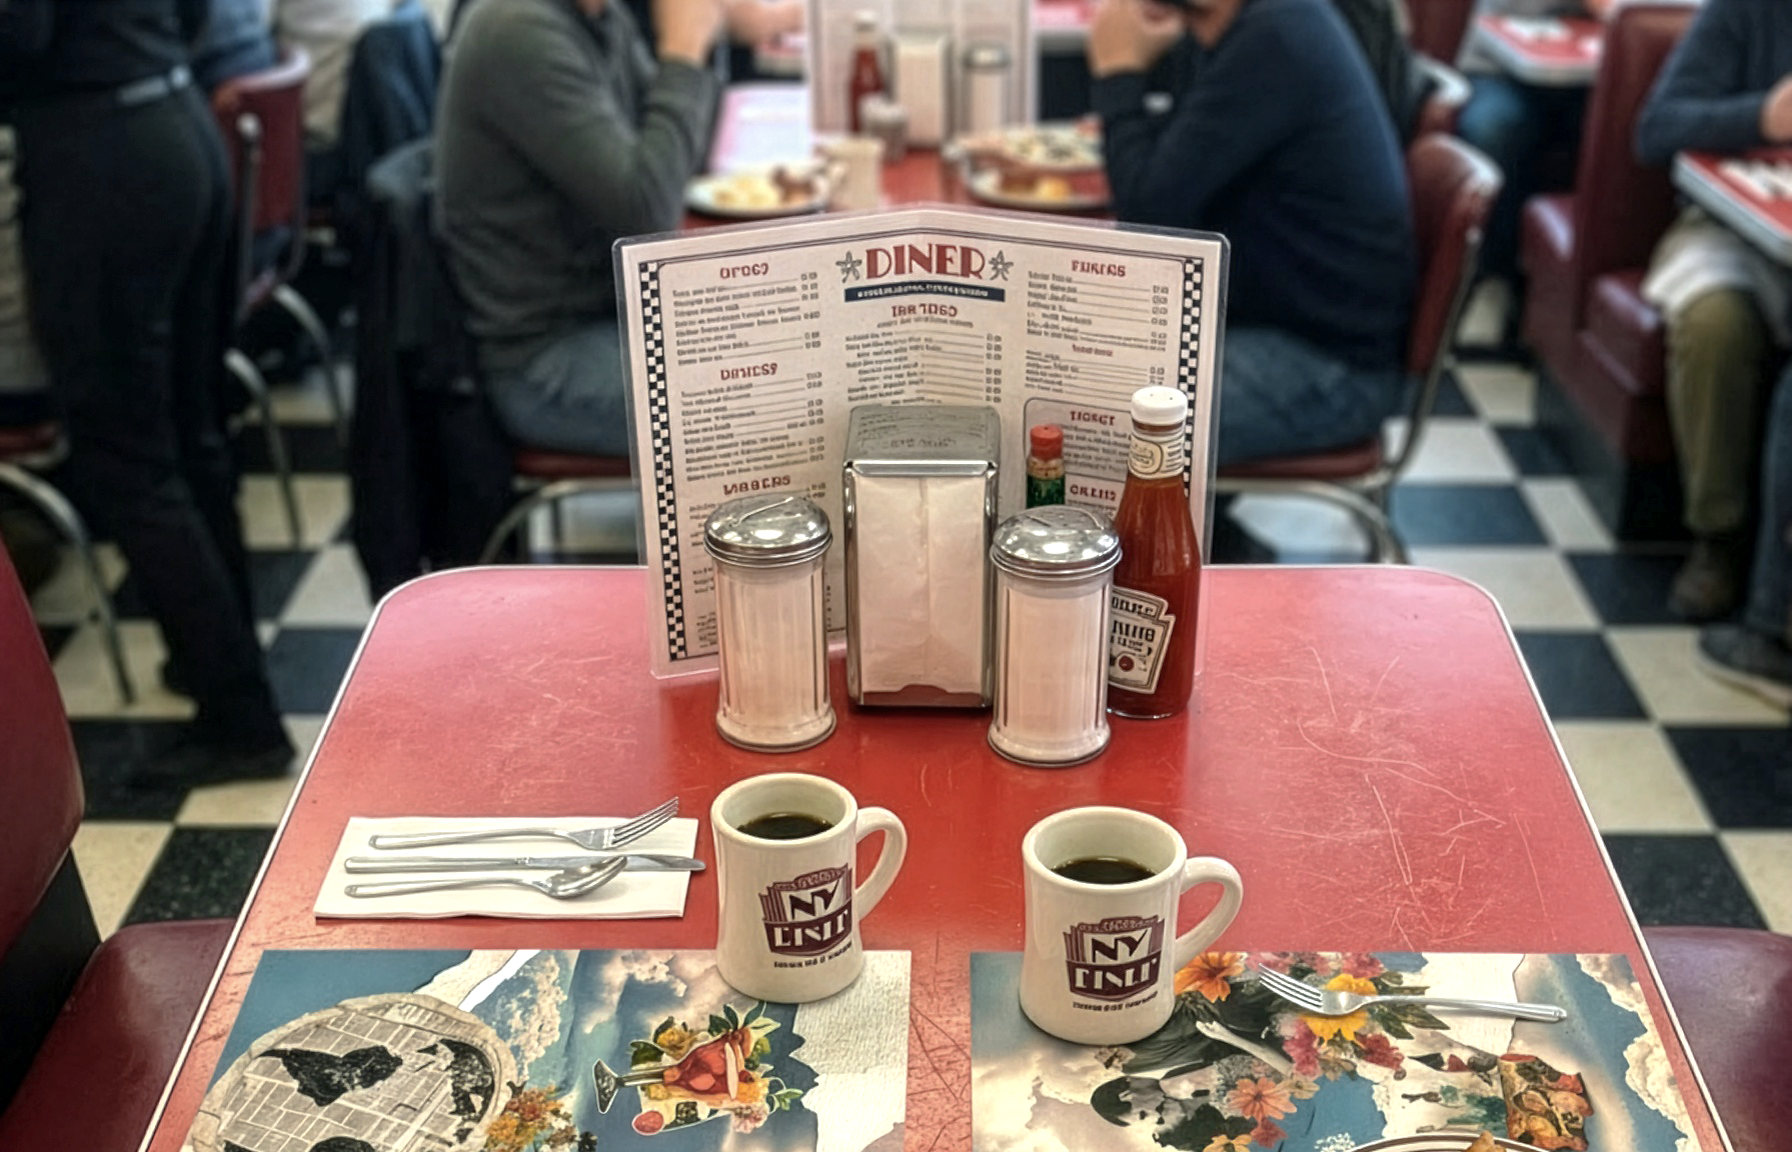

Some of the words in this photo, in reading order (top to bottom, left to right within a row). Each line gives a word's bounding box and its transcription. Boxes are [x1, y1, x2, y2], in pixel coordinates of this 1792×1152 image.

[866, 243, 986, 280] DINER
[789, 880, 840, 920] NY
[1091, 929, 1148, 963] NY
